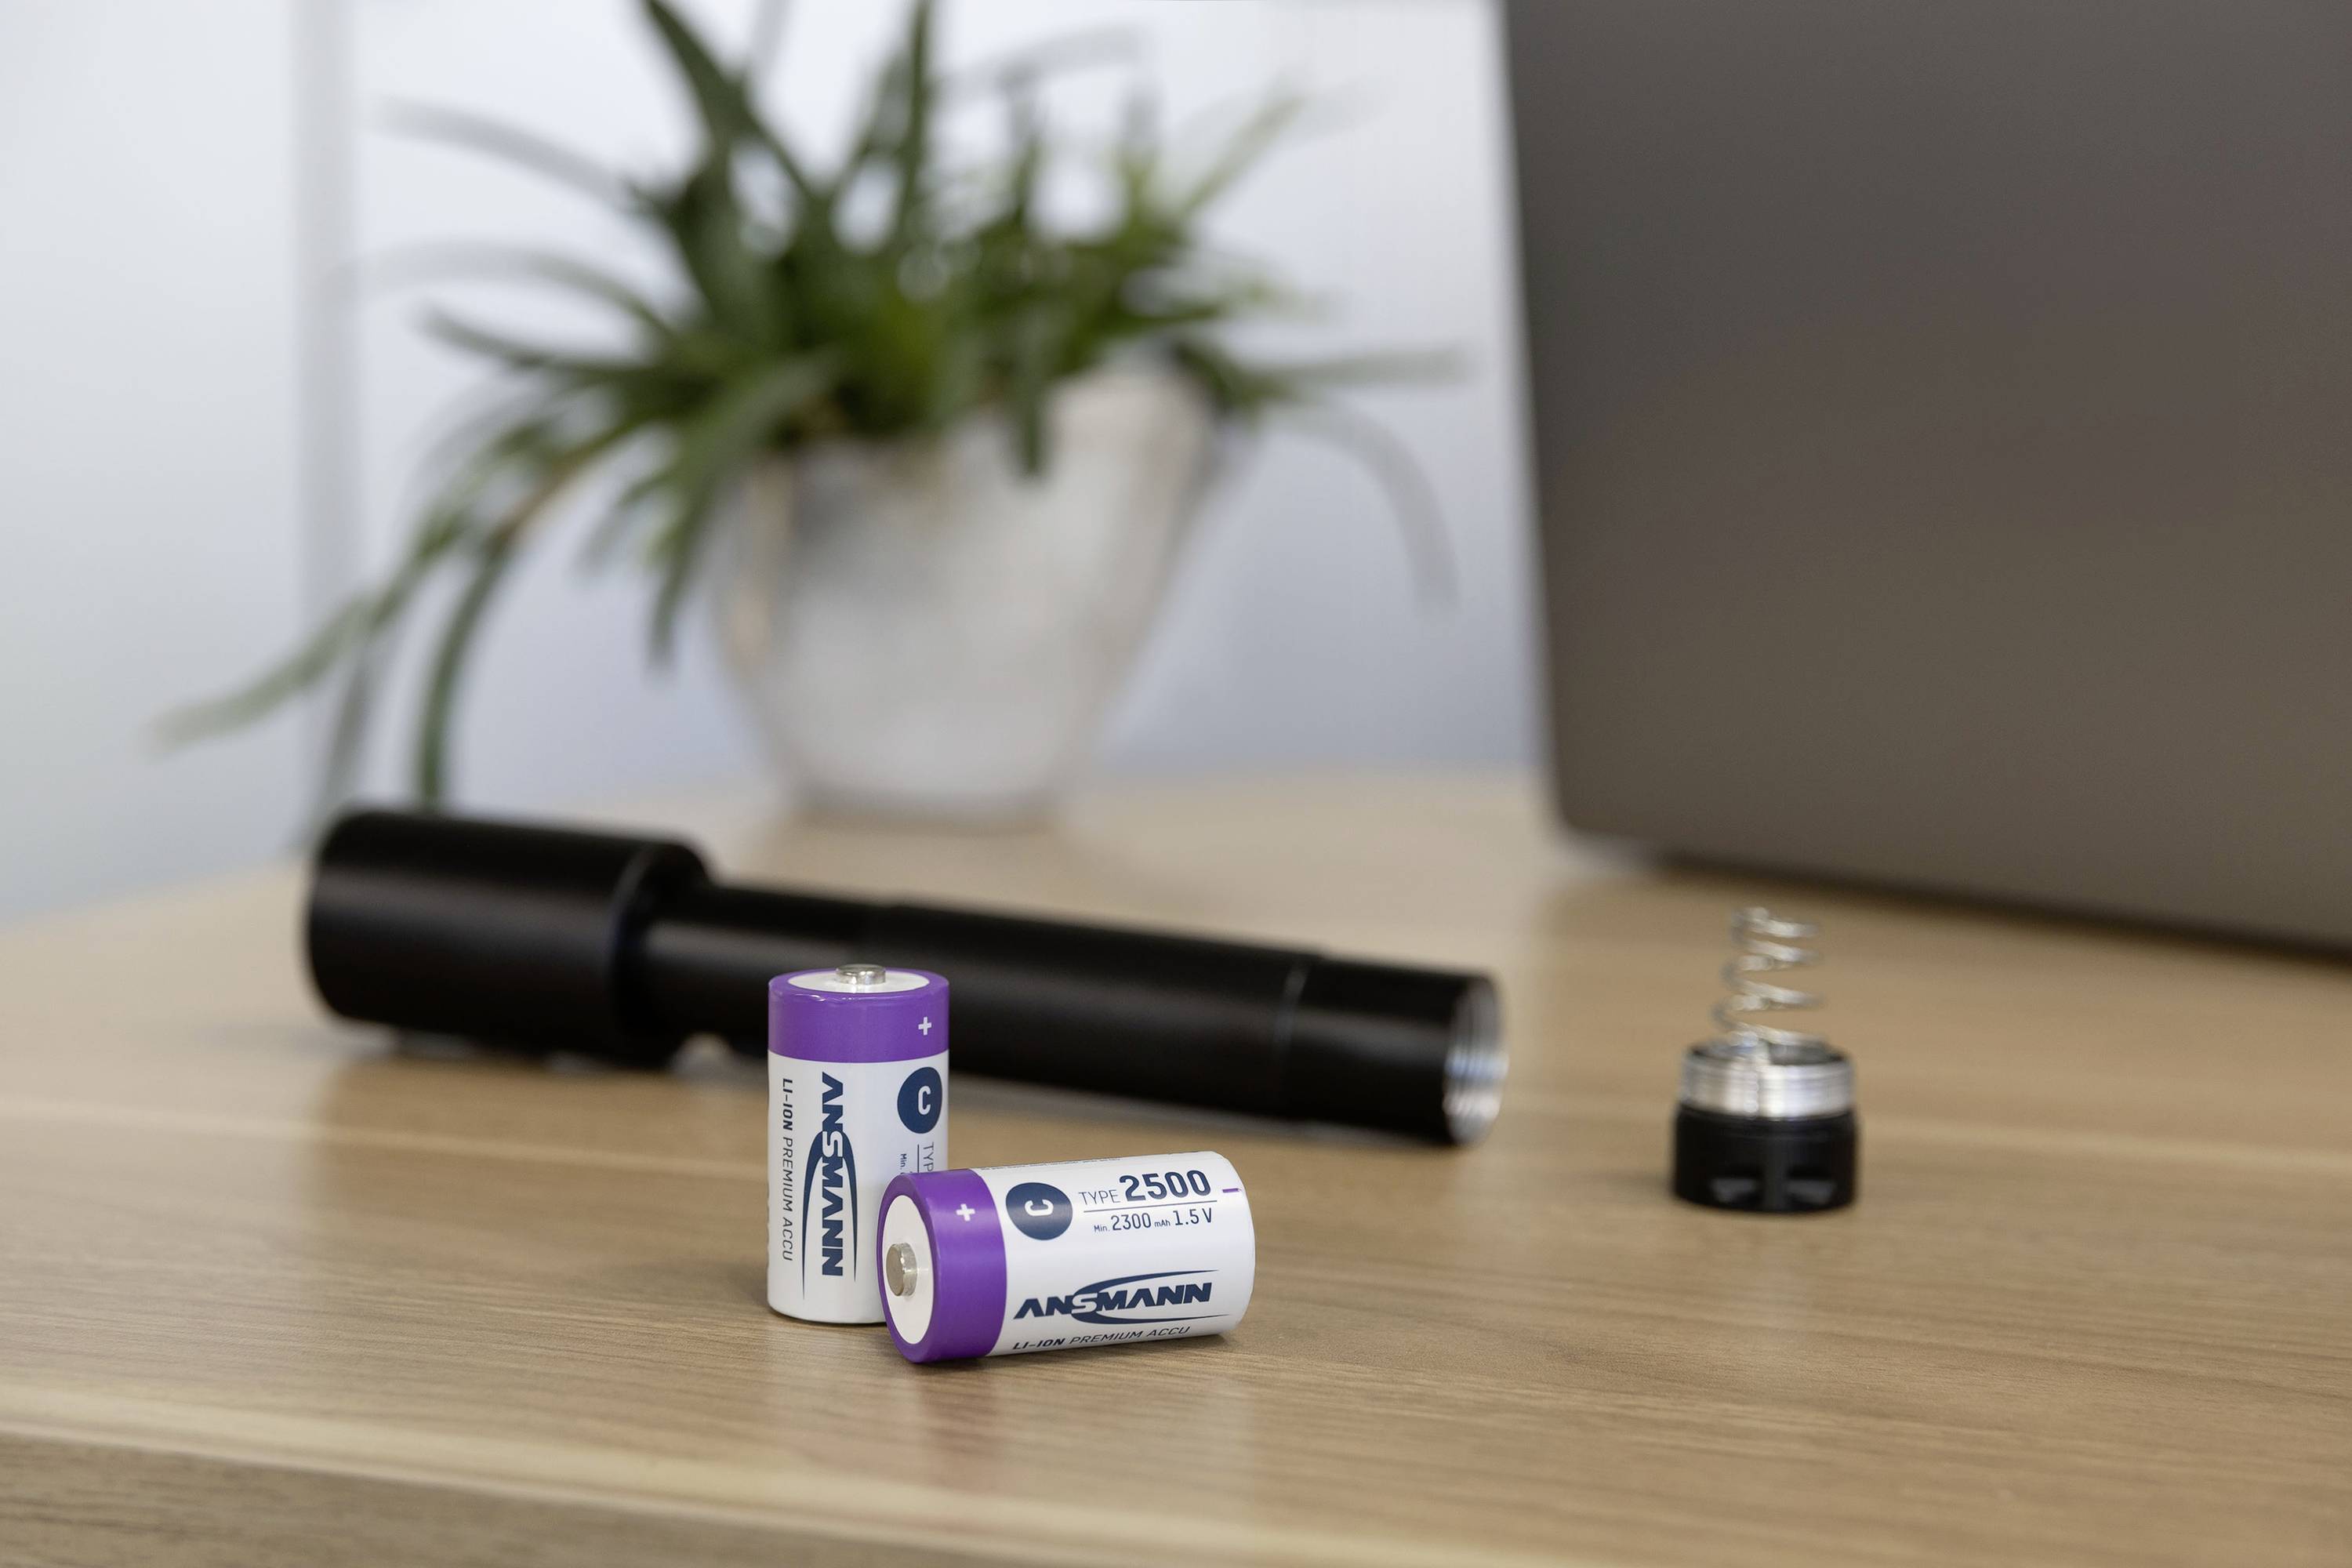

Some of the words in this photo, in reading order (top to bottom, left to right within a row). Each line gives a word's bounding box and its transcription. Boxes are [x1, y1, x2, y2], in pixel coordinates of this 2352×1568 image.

[782, 1078, 793, 1131] LI-ION
[917, 1085, 931, 1115] C
[822, 1071, 843, 1276] ANSMANN
[899, 1153, 908, 1171] Min.
[923, 1142, 935, 1172] TYP
[782, 1136, 793, 1212] PREMIUM
[1078, 1189, 1121, 1206] TYPE
[1119, 1170, 1212, 1202] 2500
[1024, 1199, 1054, 1217] C
[1093, 1225, 1110, 1233] Min.
[1110, 1212, 1152, 1232] 2300
[1154, 1218, 1171, 1229] mAh
[782, 1216, 793, 1261] ACCU
[1012, 1282, 1213, 1319] ANSMANN
[1012, 1338, 1066, 1350] LI-ION
[1069, 1330, 1145, 1345] PREMIUM
[1145, 1326, 1192, 1338] ACCU
